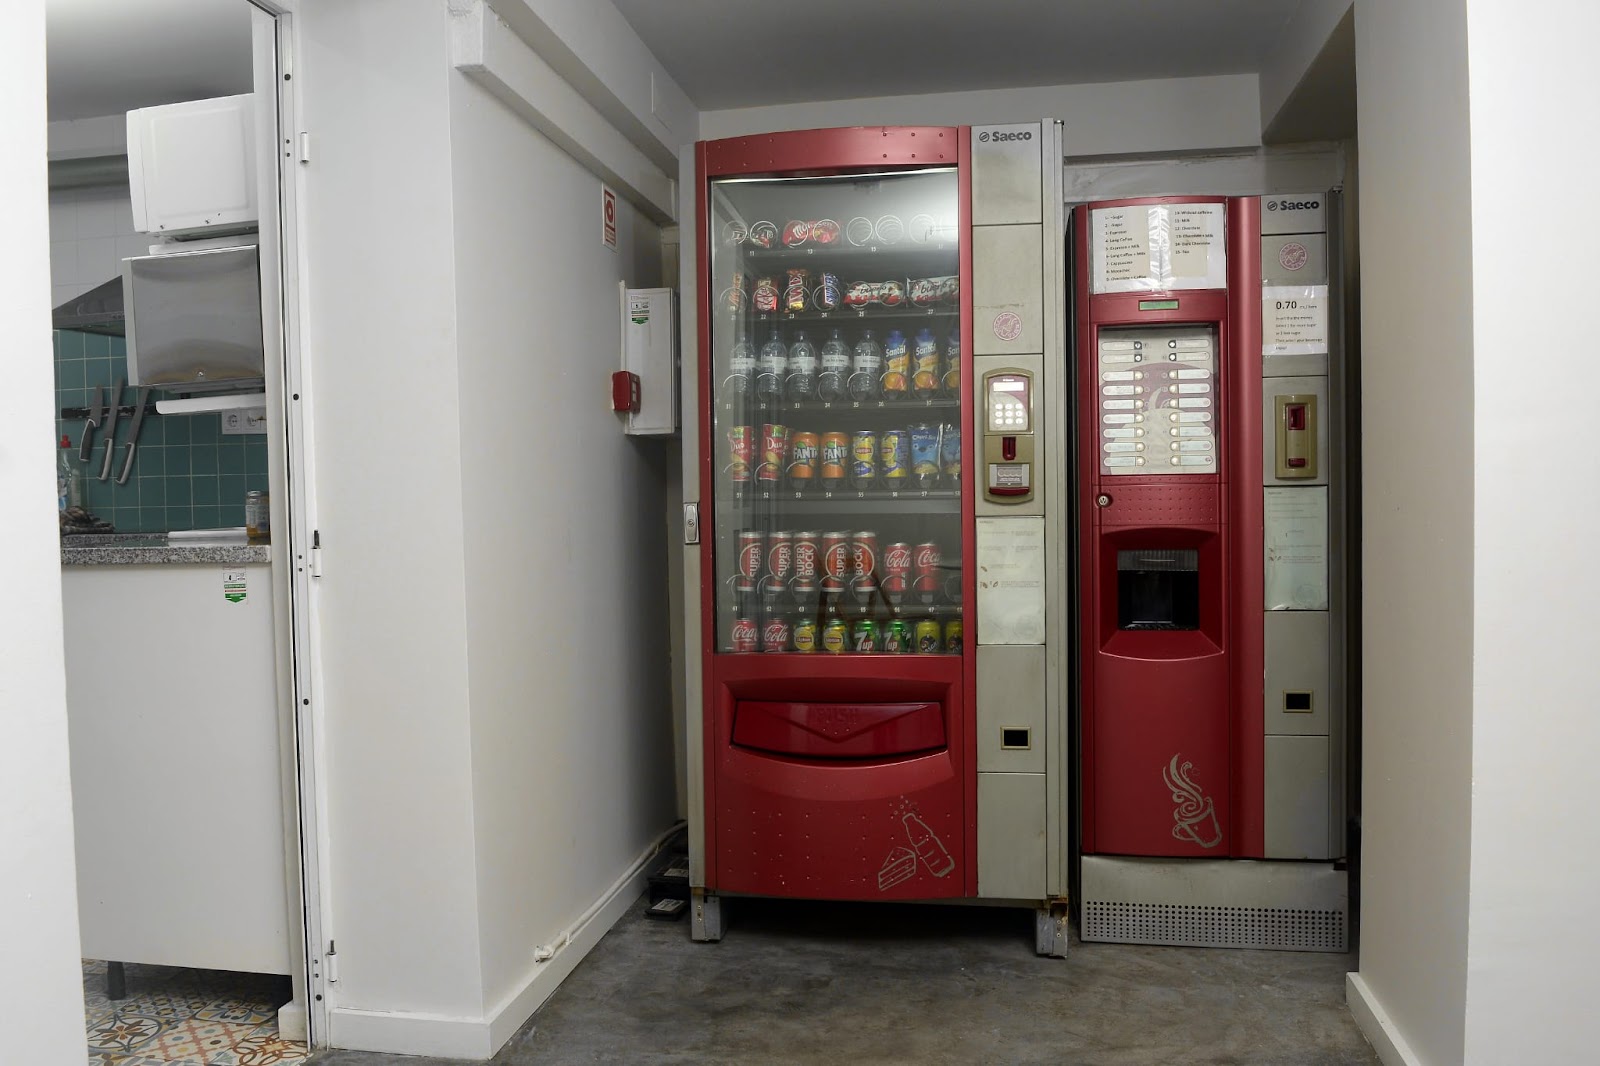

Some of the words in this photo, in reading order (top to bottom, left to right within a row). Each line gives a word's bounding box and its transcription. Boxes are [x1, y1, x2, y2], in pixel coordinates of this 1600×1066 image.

[992, 131, 1032, 142] Saeco
[1280, 200, 1320, 210] Saeco
[1276, 301, 1297, 309] 0.70
[886, 345, 906, 357] Santal
[916, 343, 936, 356] Santal
[948, 347, 960, 356] San
[767, 437, 782, 450] Duo
[750, 547, 759, 577] SUPER
[778, 547, 788, 577] SUPER
[796, 547, 805, 576] SUPER
[805, 548, 814, 576] BOCK
[836, 547, 846, 578] SUPER
[886, 549, 910, 568] Cola
[918, 549, 940, 568] Coca
[732, 624, 754, 642] Coca
[764, 624, 788, 642] Cola
